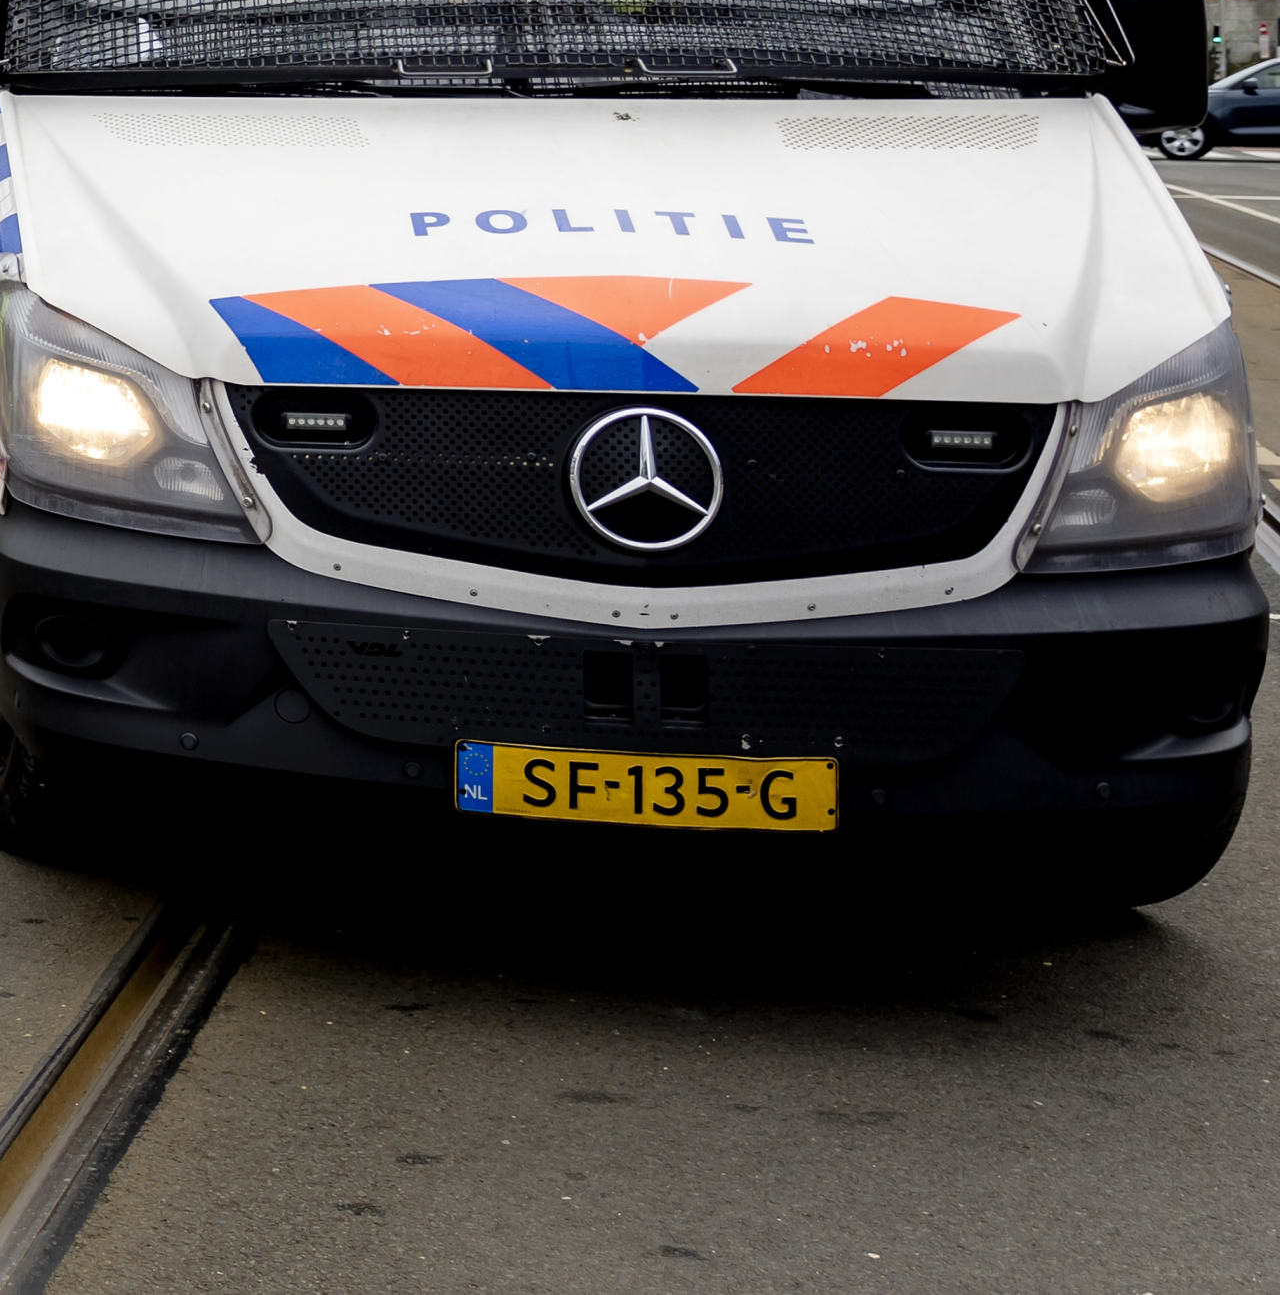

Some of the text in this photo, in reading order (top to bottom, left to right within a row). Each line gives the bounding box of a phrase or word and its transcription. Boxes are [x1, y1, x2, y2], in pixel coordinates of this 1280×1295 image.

[410, 209, 815, 245] POLITIE
[346, 640, 404, 657] VDL
[464, 757, 798, 820] NL SF-135-G
